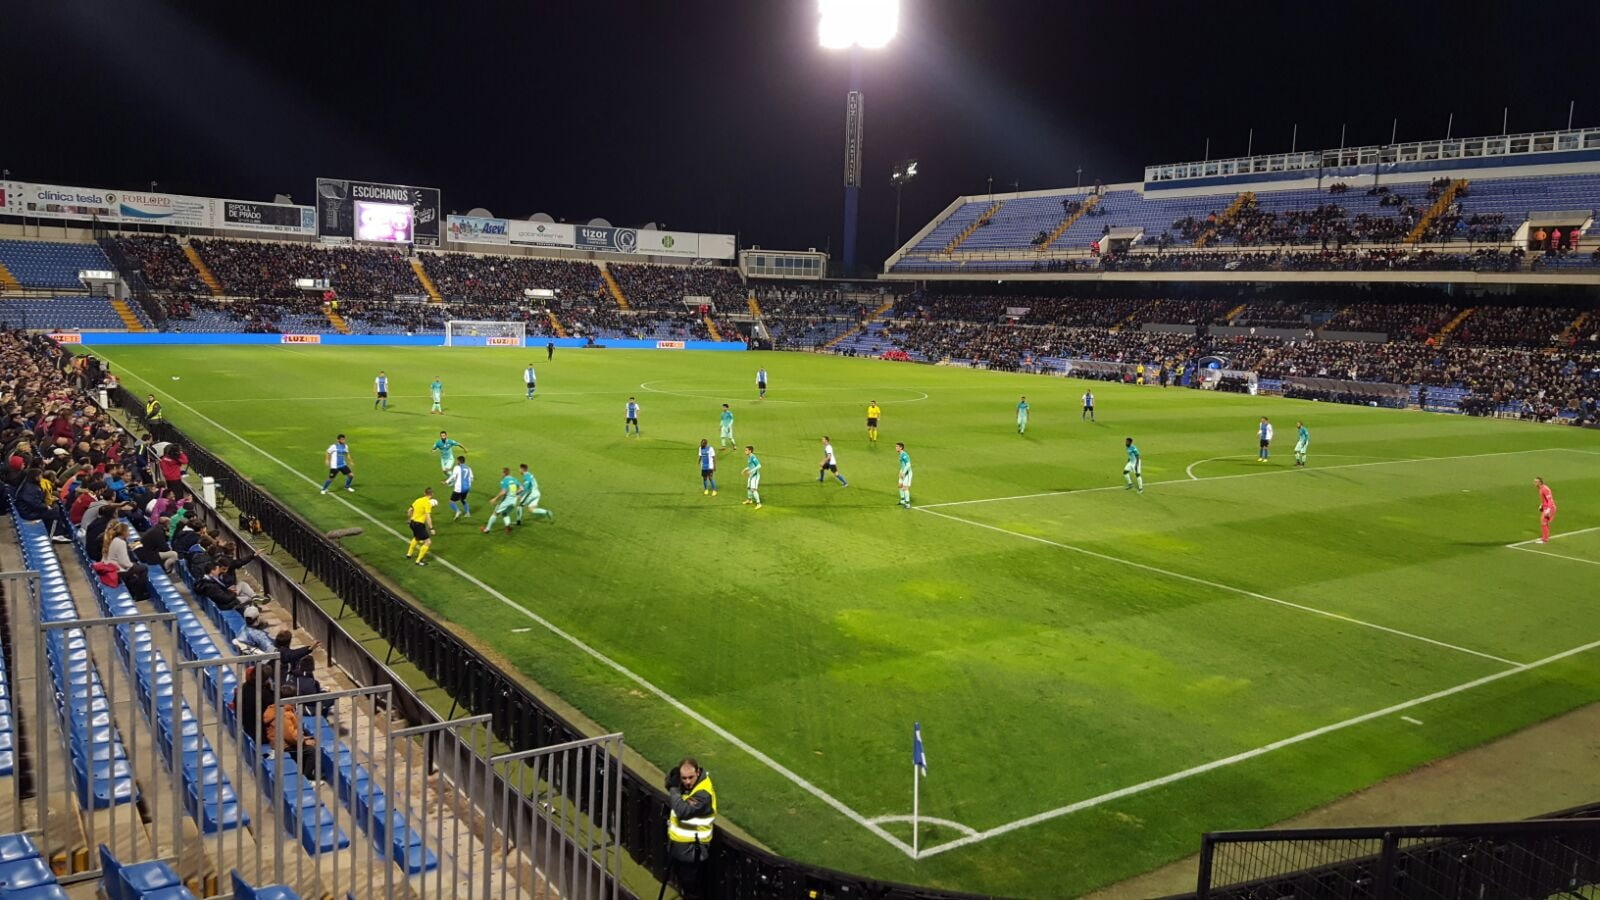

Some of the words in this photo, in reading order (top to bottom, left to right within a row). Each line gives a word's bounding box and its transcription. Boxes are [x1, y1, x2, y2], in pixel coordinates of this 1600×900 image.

[37, 190, 74, 201] clínica
[76, 193, 103, 204] tesla
[352, 185, 408, 200] ESCÚCHANOS
[228, 203, 251, 212] RIPOLL
[228, 210, 238, 218] DE
[239, 211, 261, 219] PRADO
[481, 222, 506, 236] Asevi
[582, 228, 608, 239] tizor
[463, 468, 469, 479] 7
